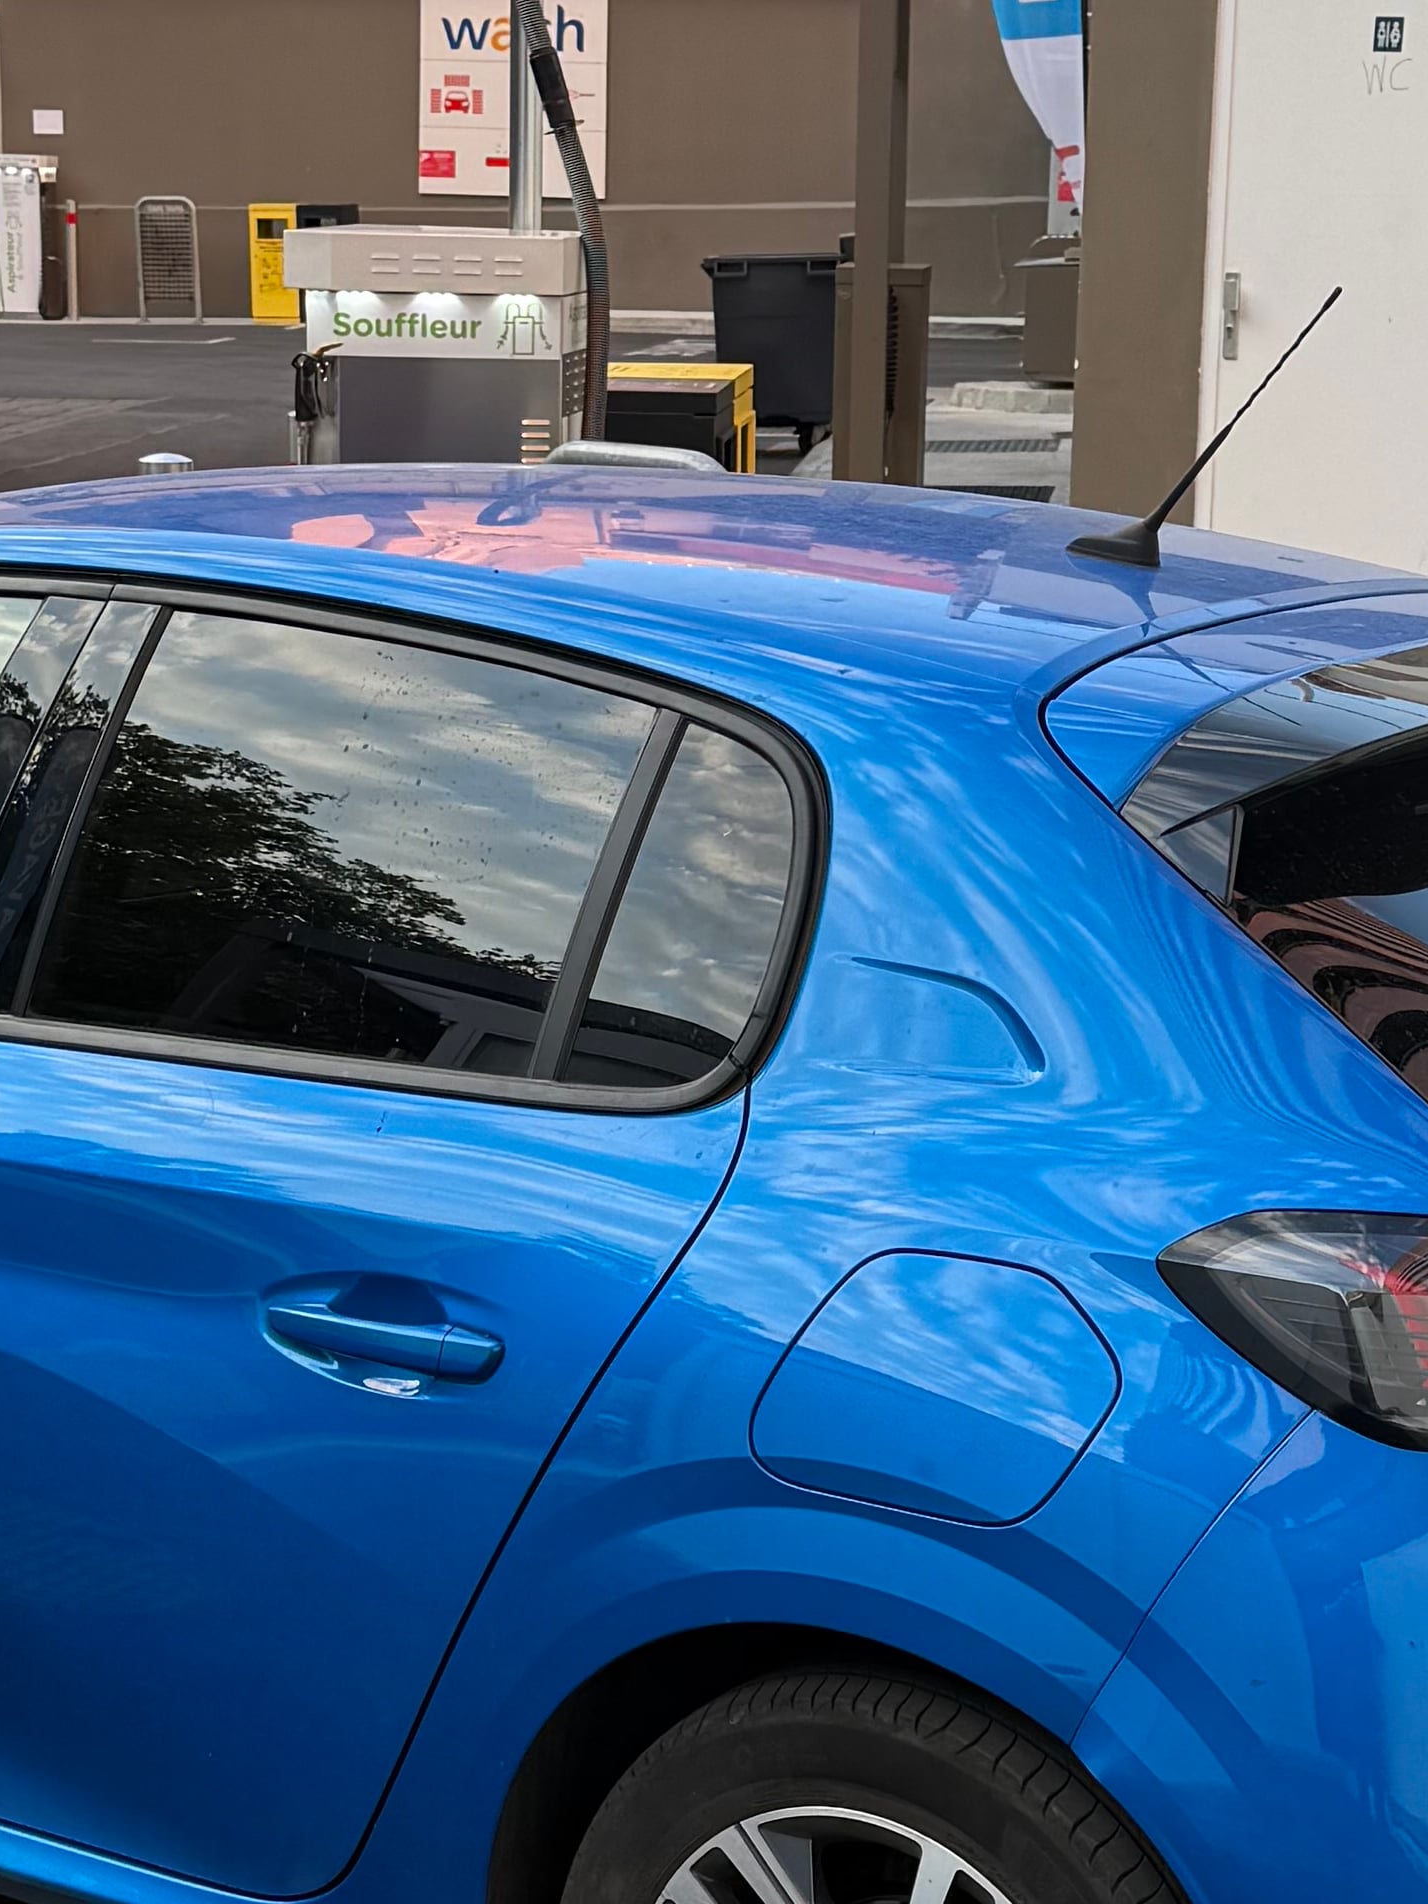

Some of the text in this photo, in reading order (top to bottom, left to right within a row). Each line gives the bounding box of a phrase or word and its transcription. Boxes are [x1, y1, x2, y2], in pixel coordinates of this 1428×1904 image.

[441, 4, 585, 53] wah
[1362, 55, 1413, 95] WC
[333, 312, 482, 339] Souffleur
